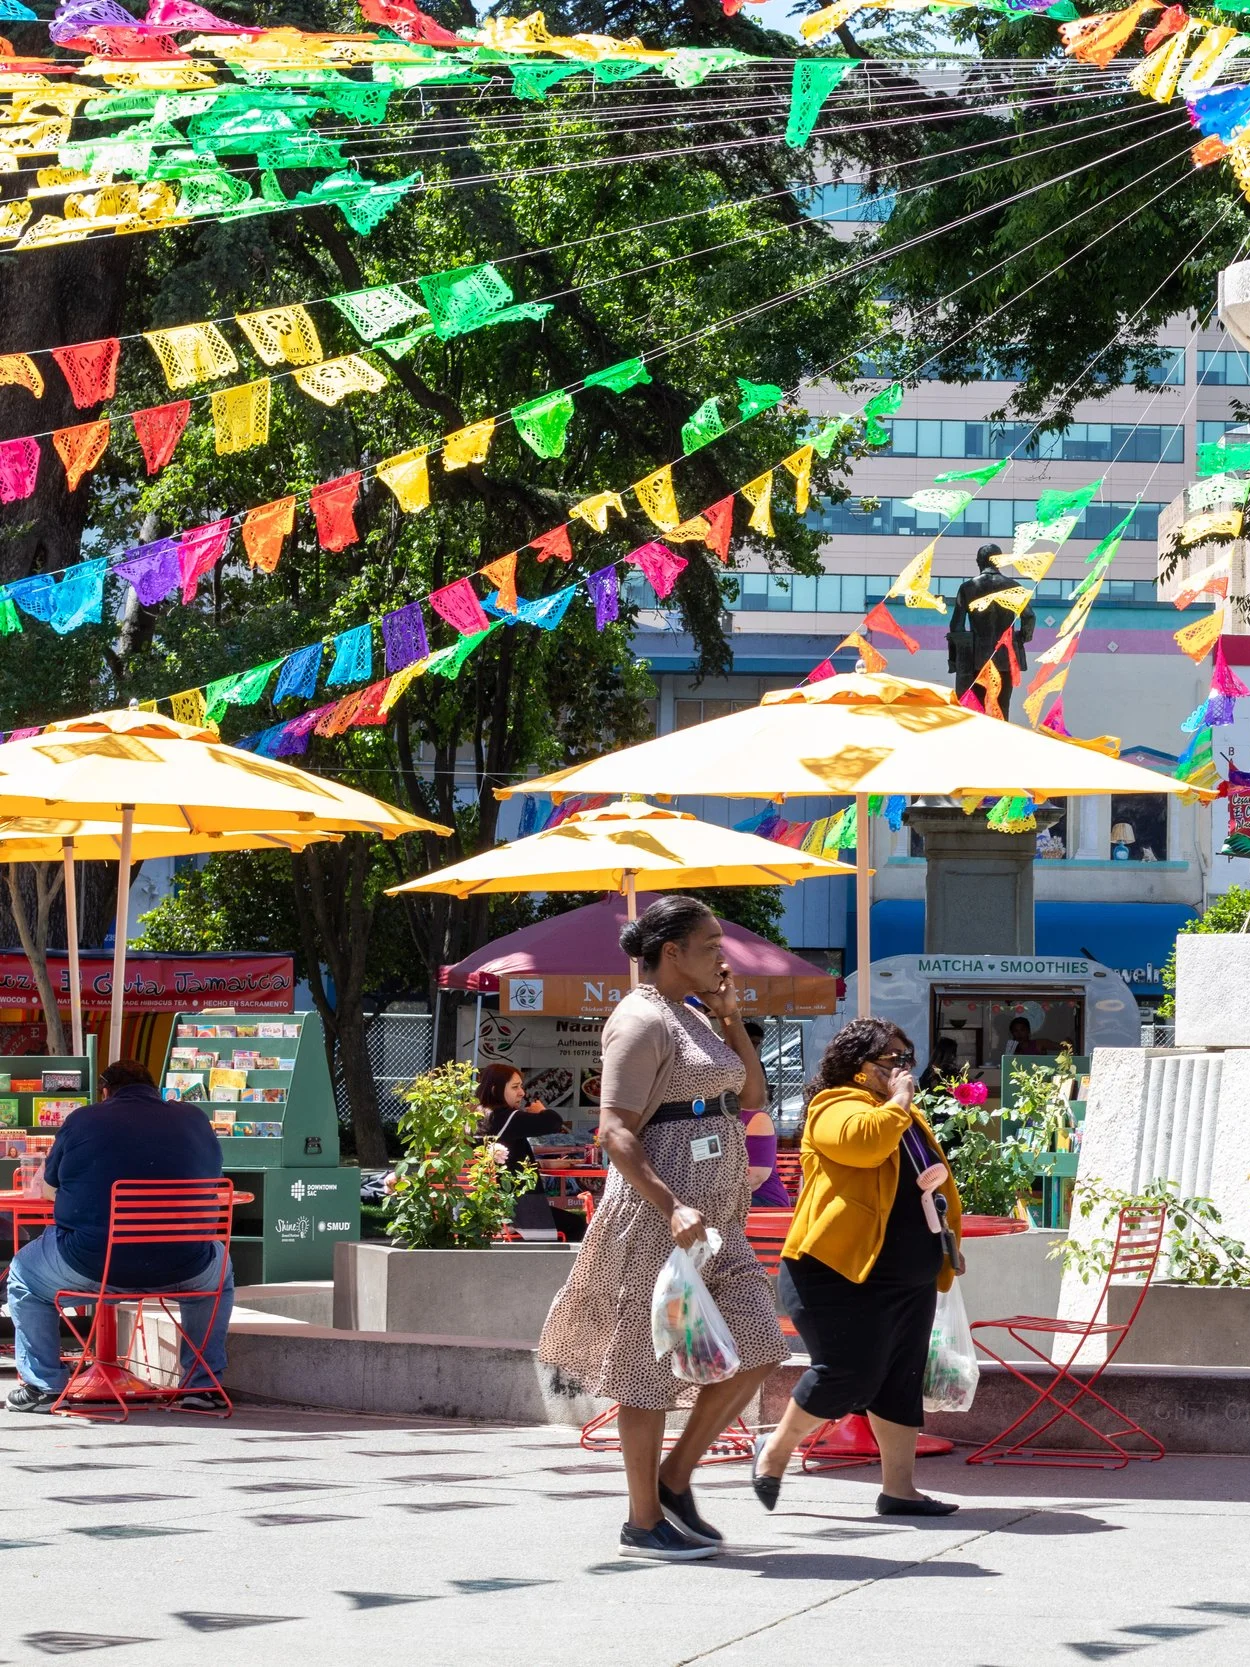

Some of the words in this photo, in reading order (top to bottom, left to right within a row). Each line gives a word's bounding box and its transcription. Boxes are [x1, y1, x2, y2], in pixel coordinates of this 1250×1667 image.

[918, 959, 984, 972] MATCHA
[1000, 960, 1089, 974] SMOOTHIES
[174, 971, 291, 994] Jamaica
[240, 1000, 289, 1008] SACRAMENTO
[557, 1039, 599, 1047] Authentic
[275, 1218, 297, 1233] Shine
[326, 1222, 351, 1231] SMUD
